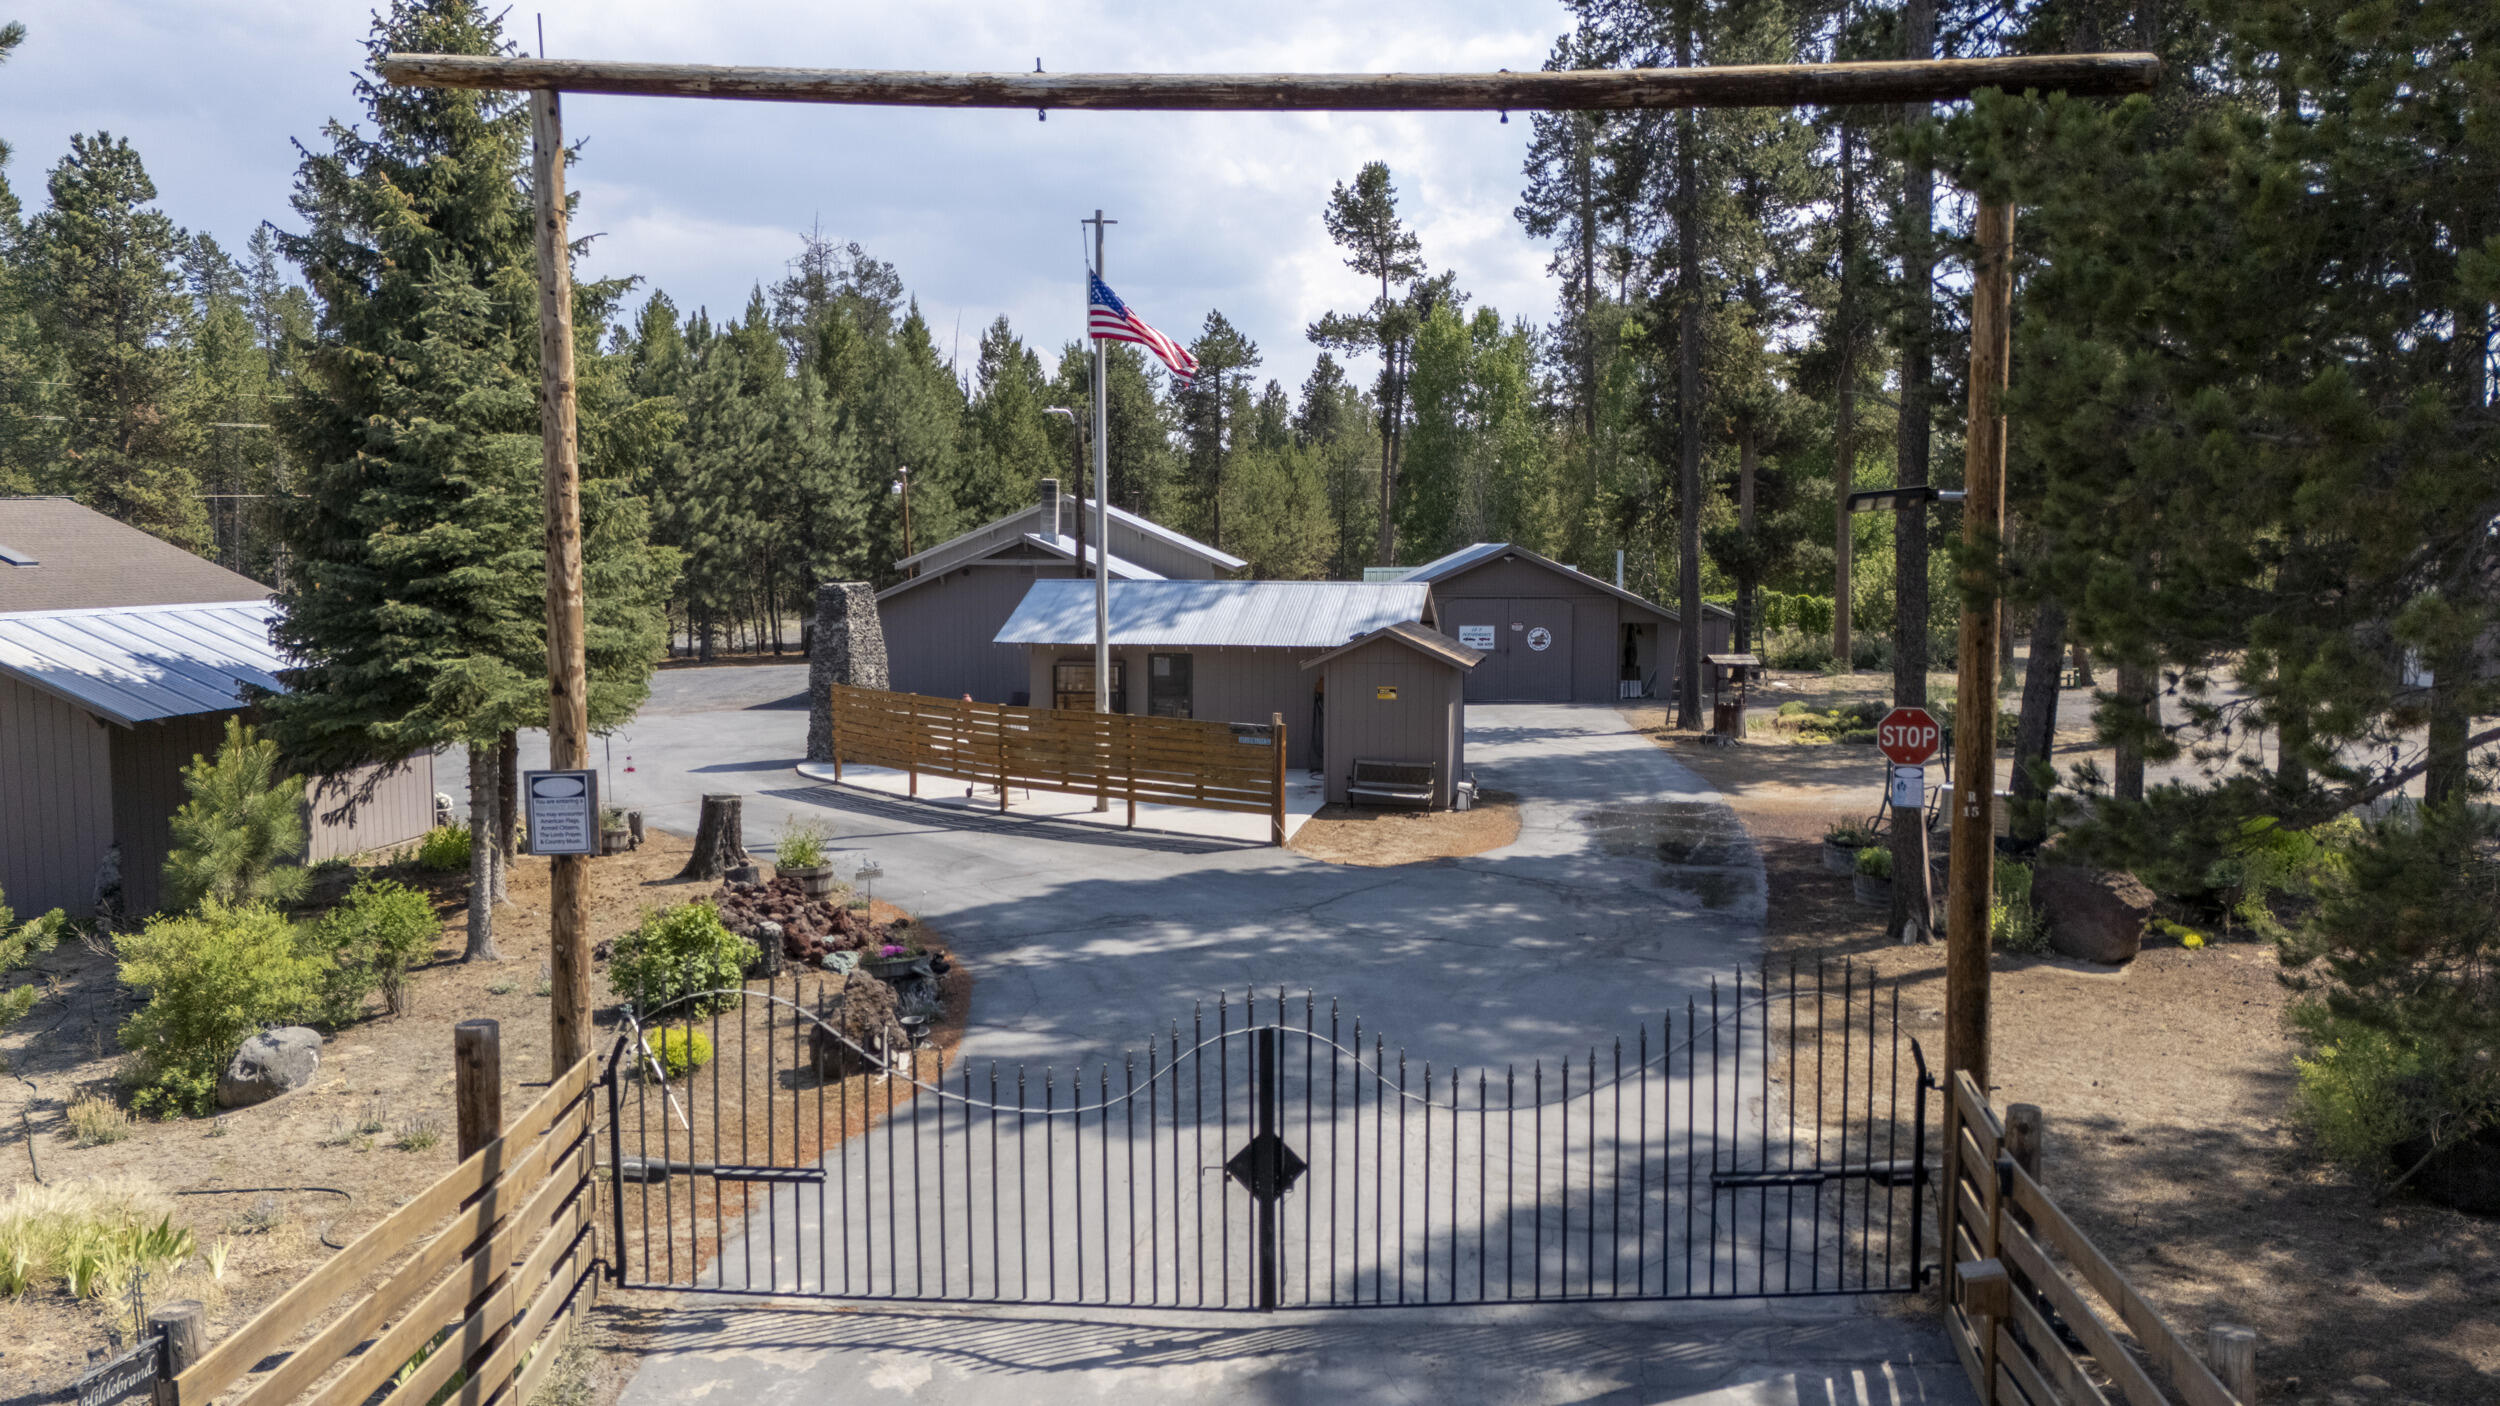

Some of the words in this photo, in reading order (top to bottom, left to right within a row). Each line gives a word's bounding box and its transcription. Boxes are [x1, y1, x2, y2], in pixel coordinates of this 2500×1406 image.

[1882, 725, 1936, 748] STOP
[1967, 791, 1977, 803] R
[1962, 805, 1980, 818] 15
[80, 1353, 158, 1406] Hildebrand
